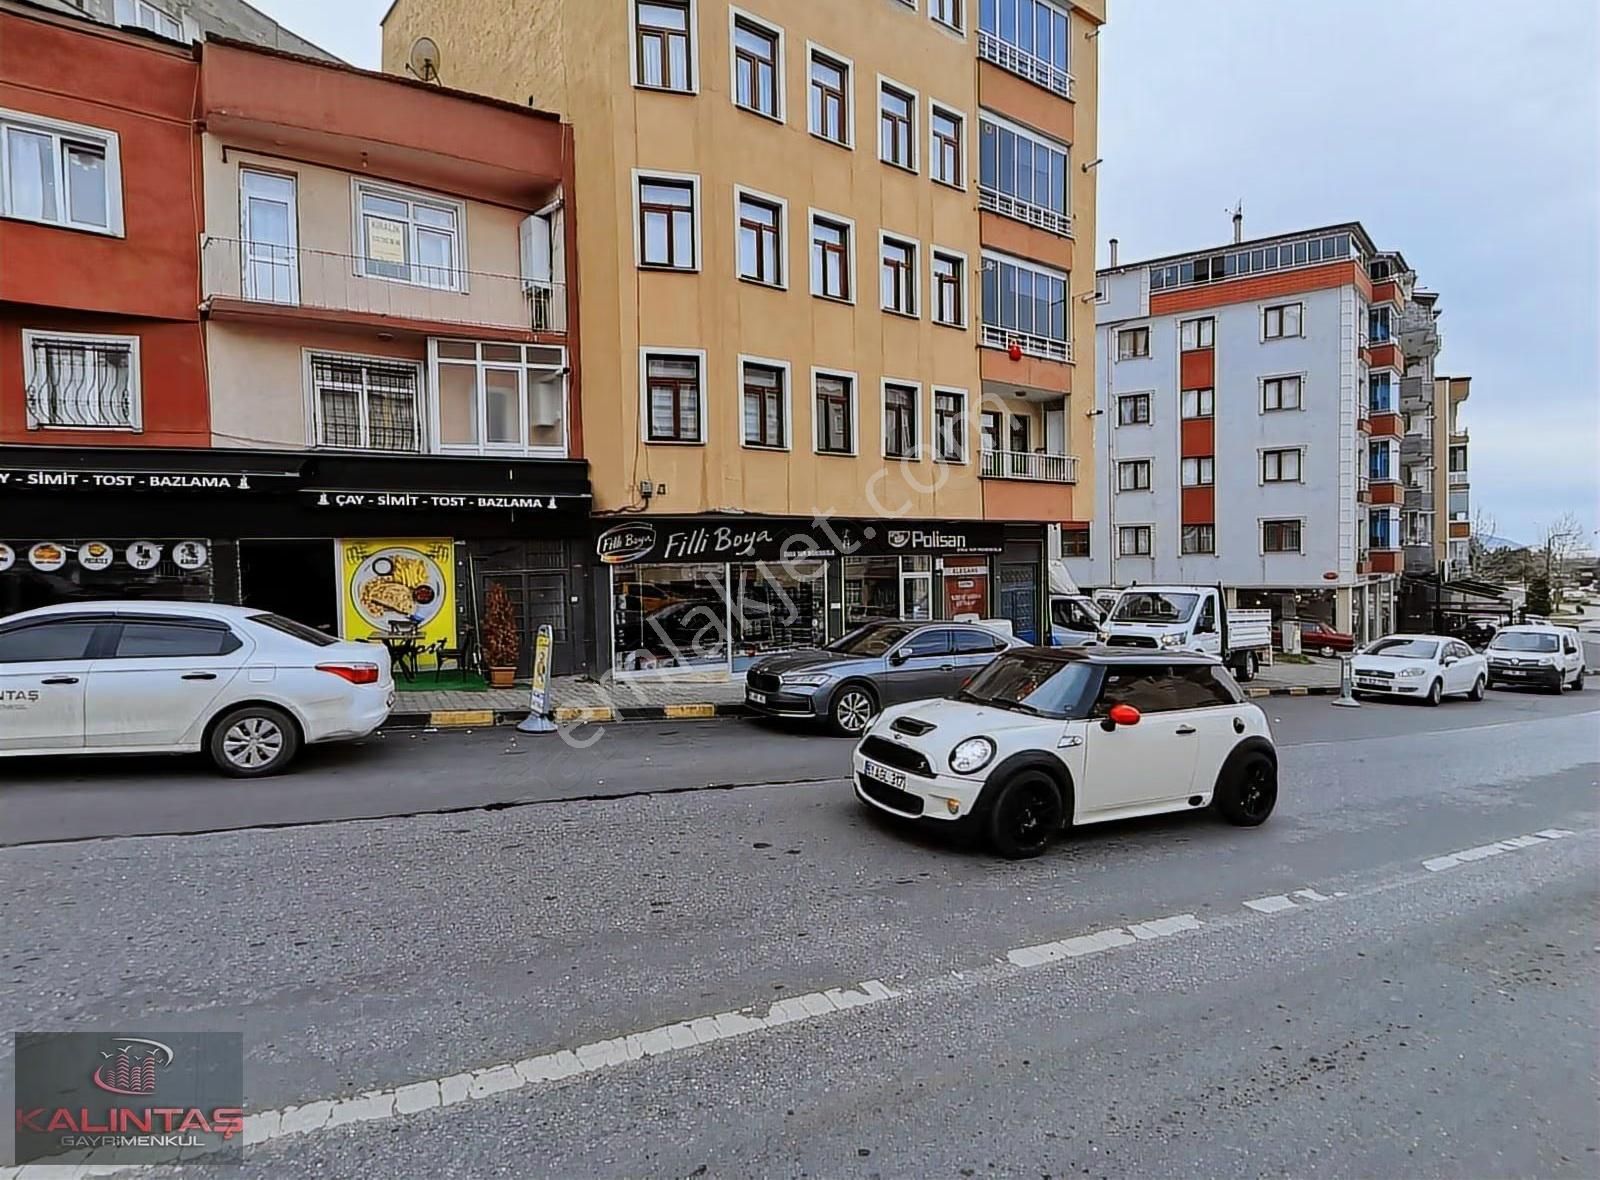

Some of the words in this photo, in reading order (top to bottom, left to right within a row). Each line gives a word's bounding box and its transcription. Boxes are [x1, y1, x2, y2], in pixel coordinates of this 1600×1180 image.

[27, 471, 79, 485] SİMİT
[92, 474, 136, 486] TOST
[149, 475, 231, 488] BAZLAMA
[335, 494, 365, 507] ÇAY
[377, 492, 419, 506] SİMİT
[430, 496, 466, 507] TOST
[478, 497, 543, 508] BAZLAMA
[664, 528, 710, 559] Filli
[714, 527, 773, 556] Boya
[912, 530, 966, 548] Polisan
